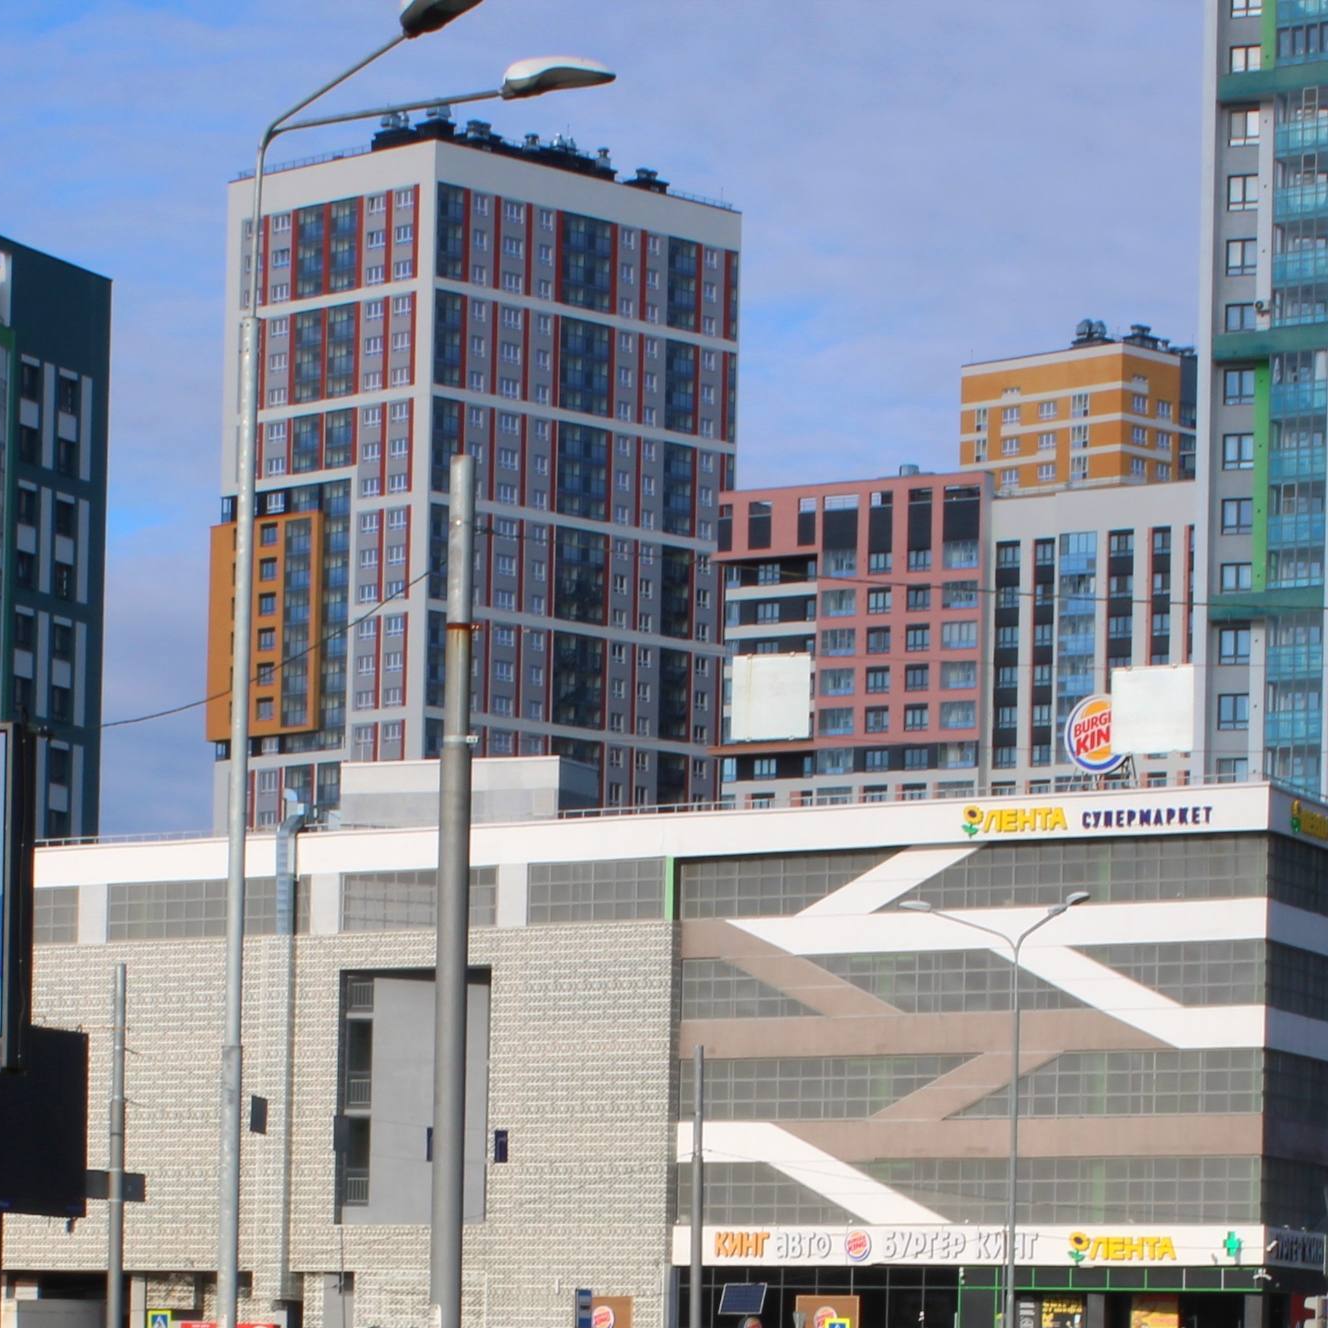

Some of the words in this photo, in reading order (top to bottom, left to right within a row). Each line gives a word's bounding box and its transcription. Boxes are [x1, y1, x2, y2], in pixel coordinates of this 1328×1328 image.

[1075, 710, 1111, 738] BURG
[1076, 725, 1110, 757] KIN
[983, 807, 1068, 832] ЛЕНТА
[1081, 806, 1213, 829] СУПЕРМАРКЕТ
[715, 1231, 770, 1258] КИНГ
[883, 1231, 967, 1260] БУРГЕР
[1088, 1236, 1177, 1261] ЛЕНТА
